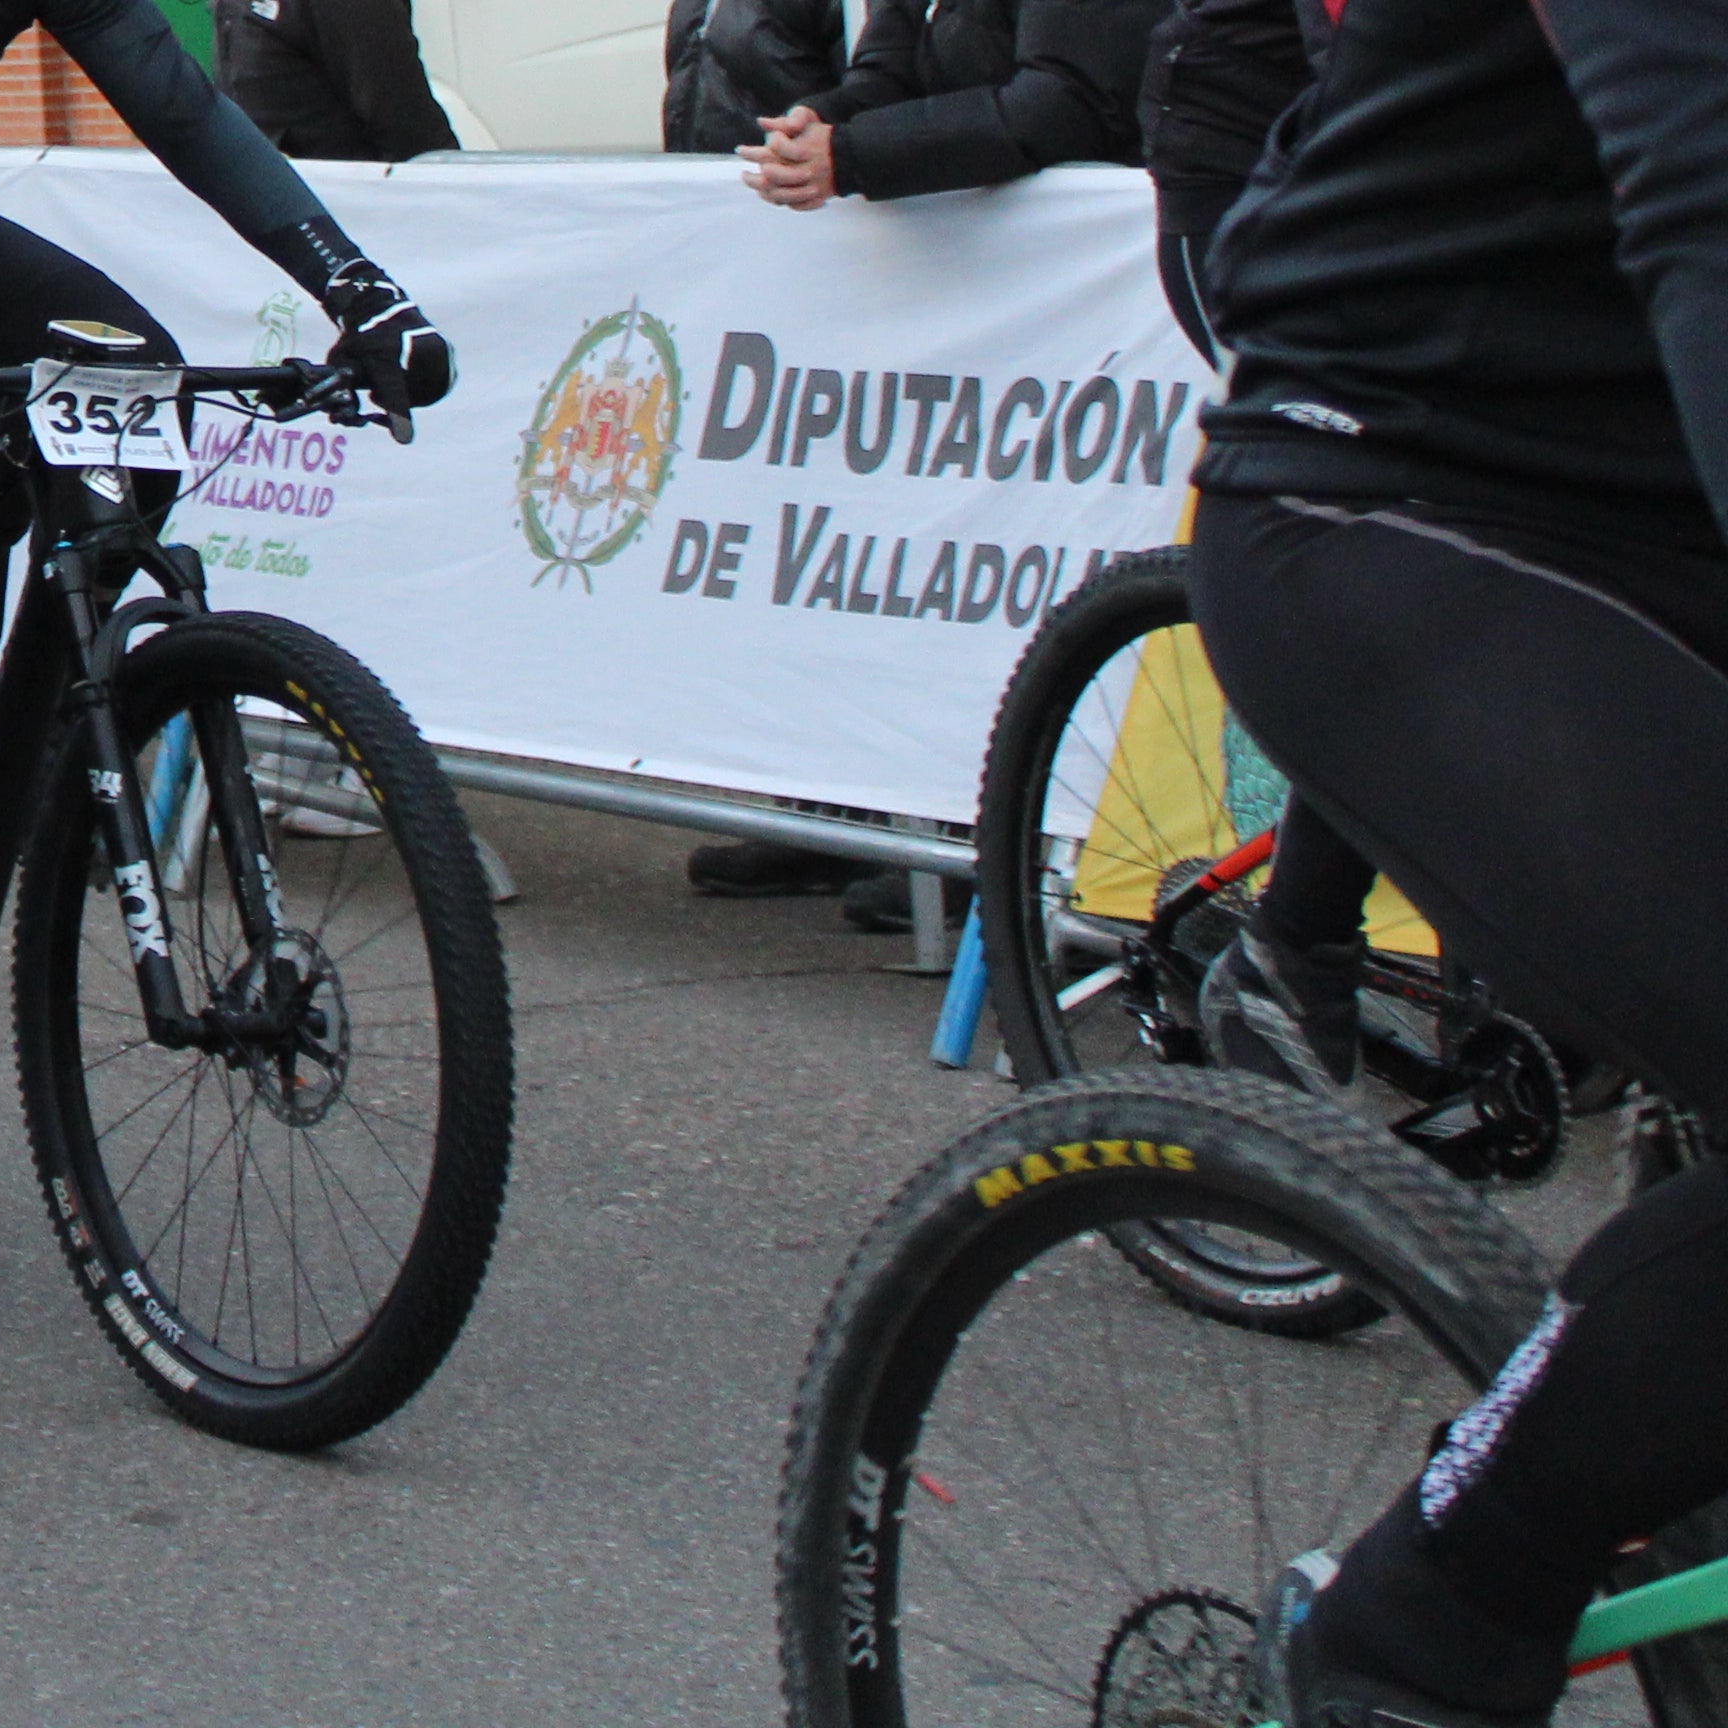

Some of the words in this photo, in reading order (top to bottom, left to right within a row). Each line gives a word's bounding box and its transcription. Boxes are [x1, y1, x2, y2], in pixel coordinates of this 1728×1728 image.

[48, 391, 162, 436] 352
[697, 331, 1189, 486] DIPUTACIÓN
[194, 468, 334, 518] VALLADOLID
[661, 518, 751, 600] DE
[114, 860, 170, 965] FOX
[975, 1140, 1196, 1208] MAXXIS
[847, 1452, 887, 1532] DT
[843, 1534, 879, 1670] SWISS
